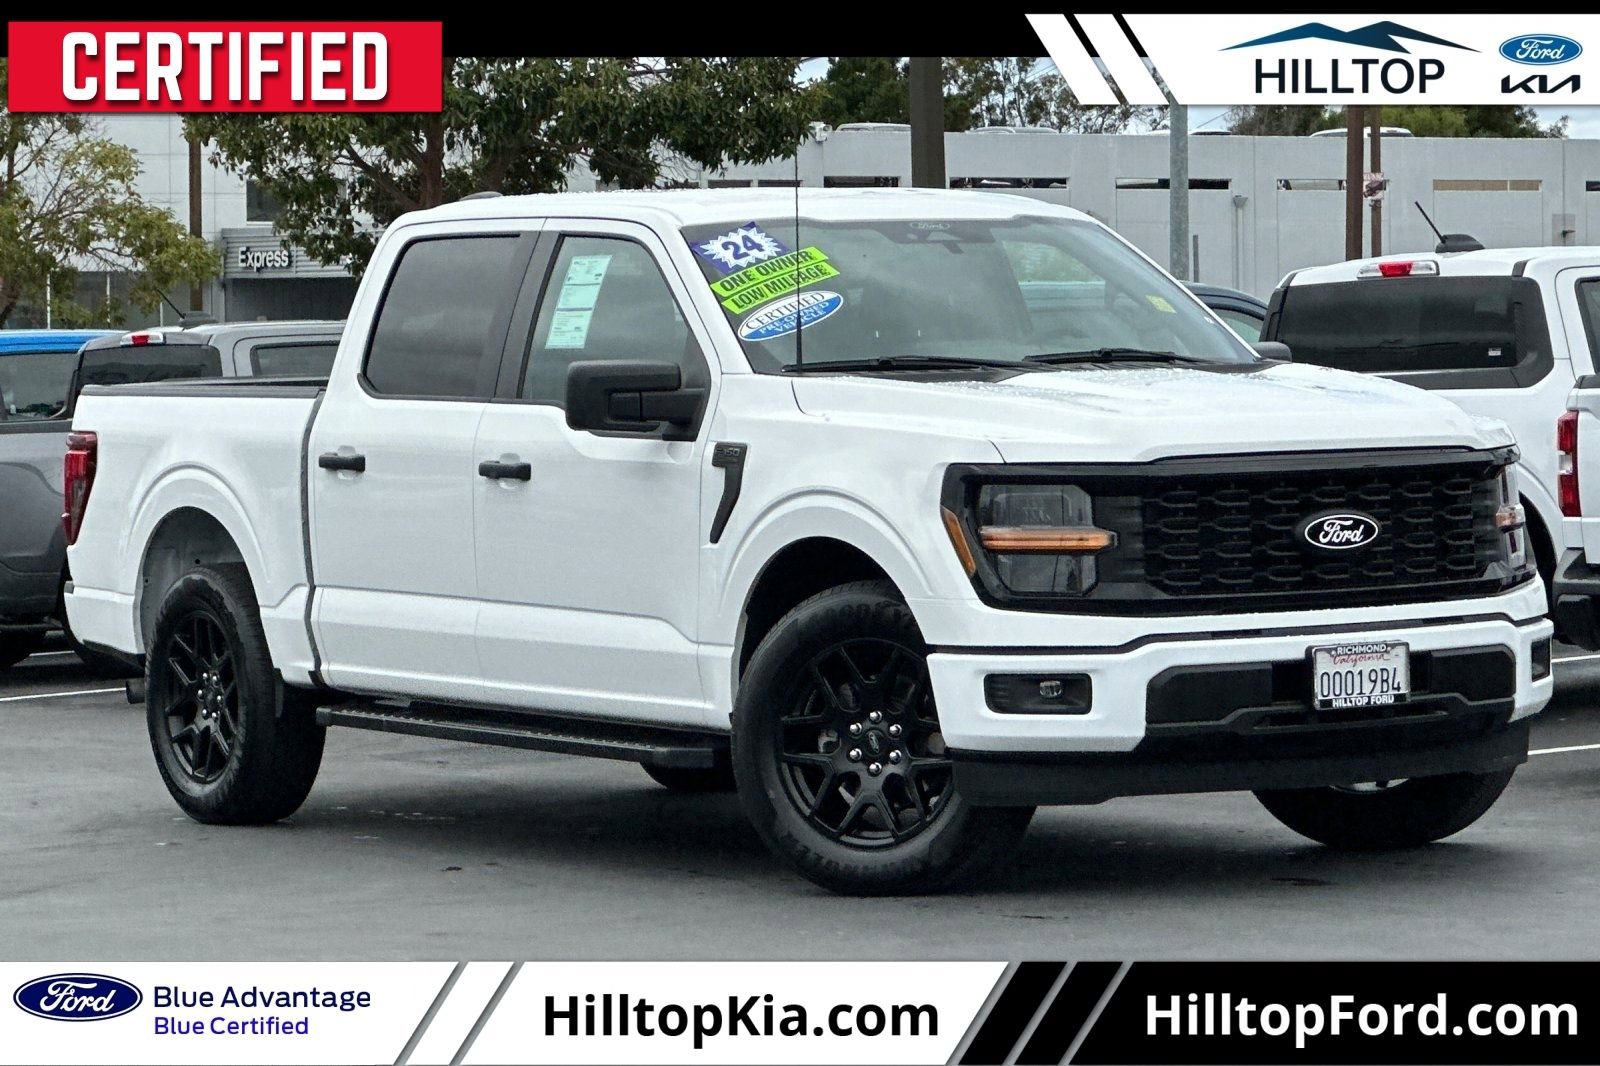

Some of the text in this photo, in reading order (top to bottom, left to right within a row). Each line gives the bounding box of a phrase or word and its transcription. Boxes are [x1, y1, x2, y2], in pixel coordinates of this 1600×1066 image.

[238, 246, 289, 272] Express
[721, 234, 765, 260] 24
[719, 249, 814, 292] ONE OWNER
[731, 263, 829, 309] LOW MILEAGE
[746, 292, 825, 330] CERTIFIED
[1318, 519, 1365, 544] Ford
[1333, 652, 1391, 667] California
[1337, 644, 1387, 655] RICHMOND
[1320, 667, 1402, 698] 00019B4
[1332, 694, 1395, 708] HILLTOP FORD
